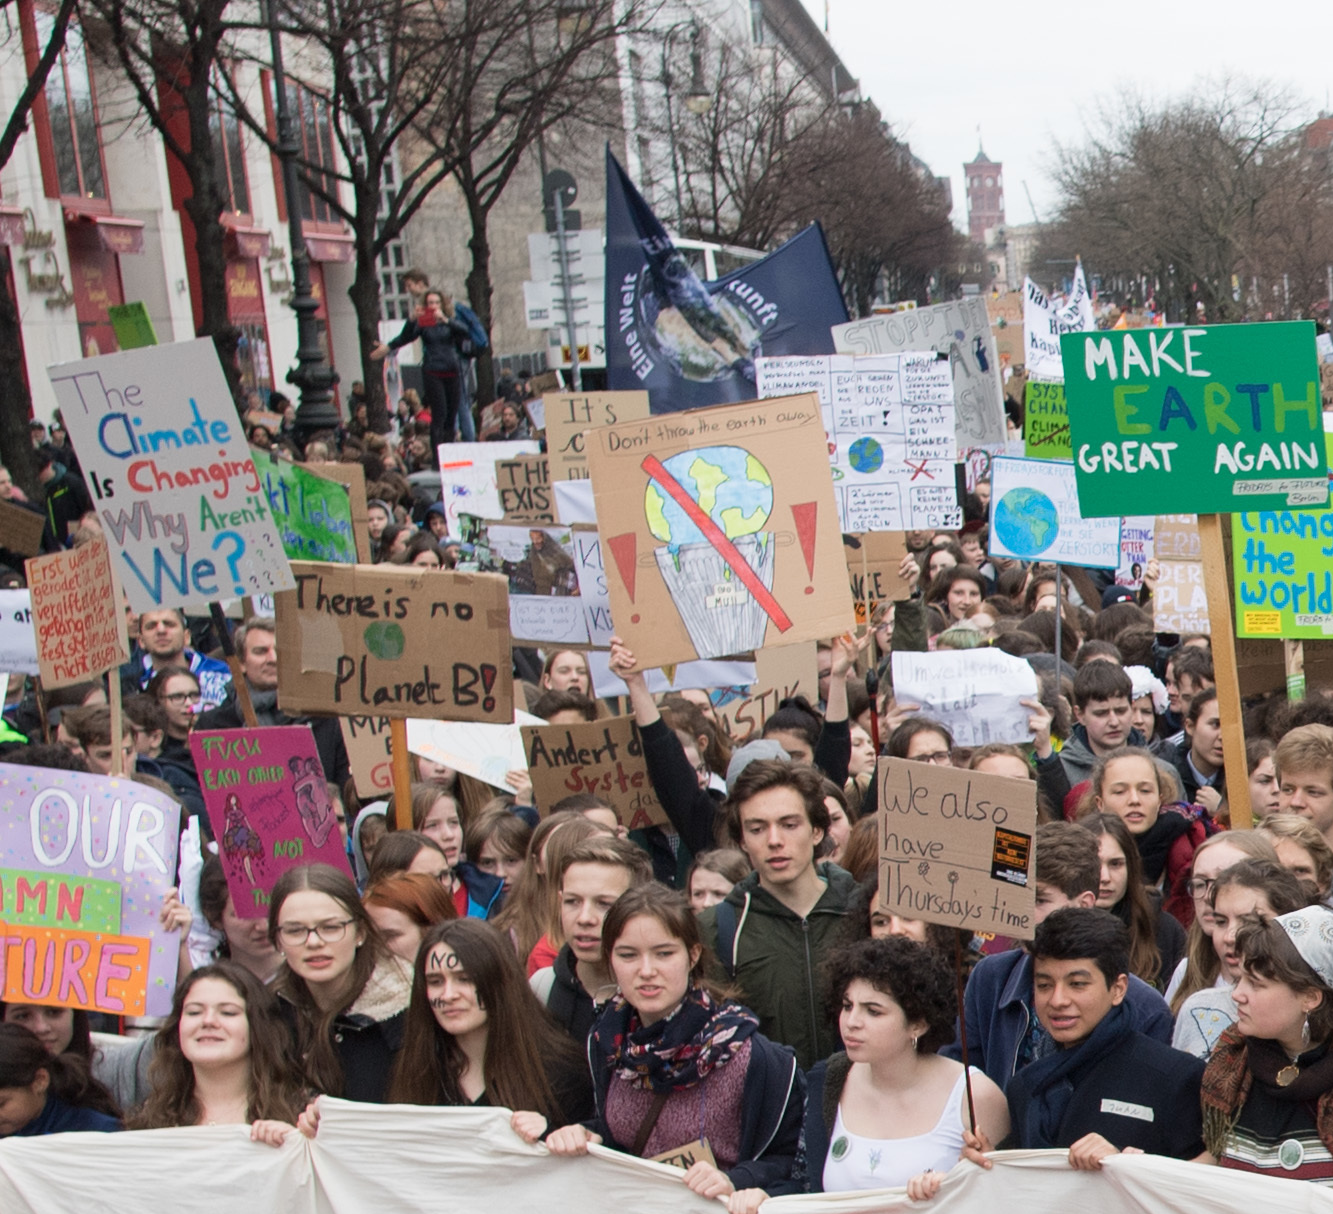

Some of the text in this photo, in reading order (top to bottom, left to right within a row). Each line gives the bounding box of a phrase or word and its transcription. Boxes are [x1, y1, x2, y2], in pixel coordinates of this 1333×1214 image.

[619, 273, 655, 381] Eine Welt
[1084, 329, 1212, 380] MAKE
[52, 370, 142, 413] The
[1113, 382, 1318, 434] EARTH
[98, 399, 233, 459] Climate
[608, 410, 816, 451] Don't throw the earth away
[90, 451, 261, 500] Is Changing
[1077, 441, 1318, 474] GREAT AGAIN
[103, 500, 189, 554] Why
[1242, 538, 1296, 577] the
[295, 573, 378, 618] There
[384, 588, 410, 619] is
[431, 601, 474, 622] no
[1240, 571, 1333, 615] world
[335, 655, 447, 706] Planet
[203, 736, 262, 761] FUCK
[530, 729, 618, 768] Ändert
[203, 766, 285, 790] EACH OTHER
[884, 767, 1008, 825] We also
[30, 788, 168, 875] OUR
[273, 838, 305, 860] NOT
[885, 813, 944, 859] have
[992, 889, 1030, 930] time
[0, 938, 138, 1011] TURE
